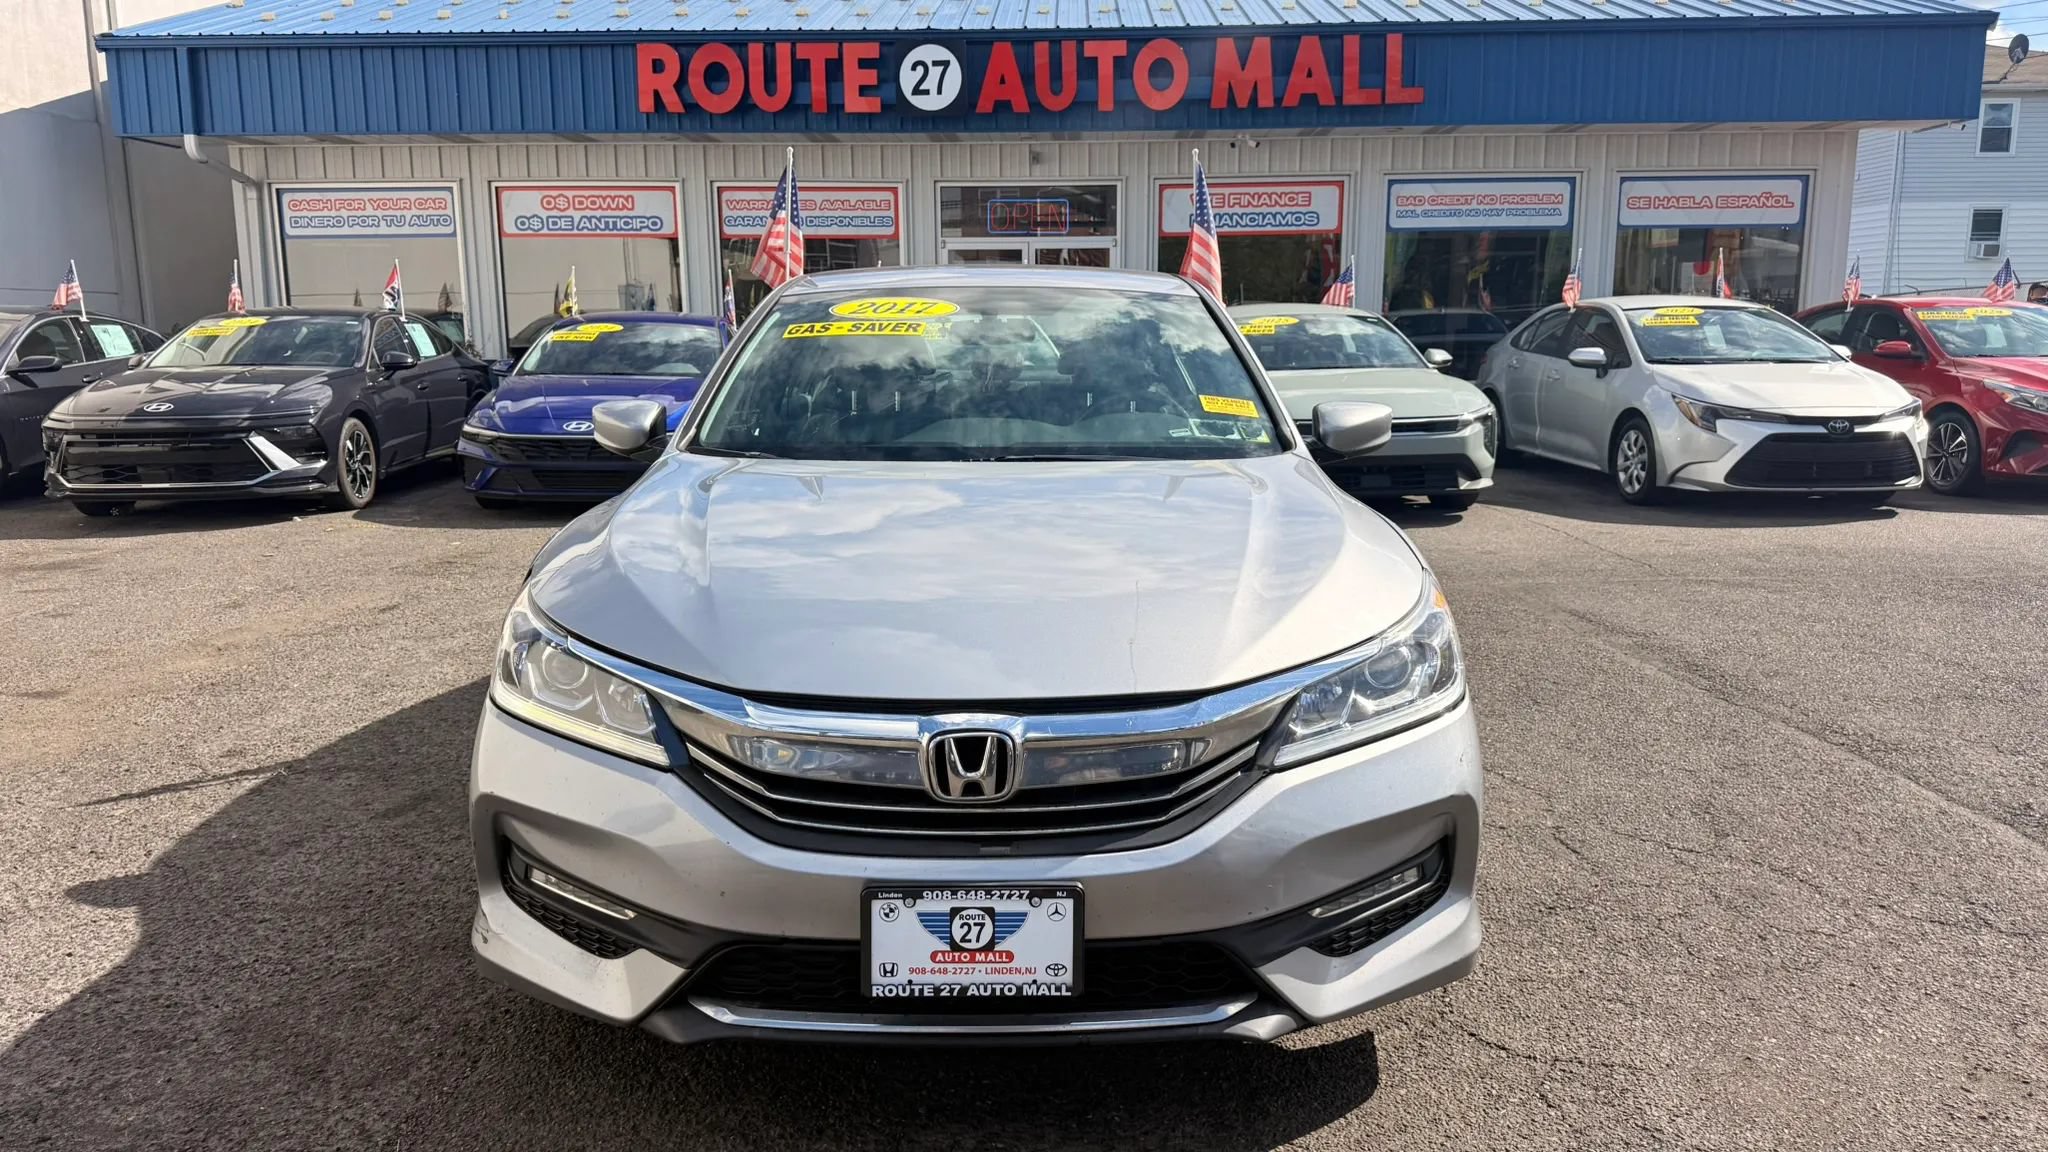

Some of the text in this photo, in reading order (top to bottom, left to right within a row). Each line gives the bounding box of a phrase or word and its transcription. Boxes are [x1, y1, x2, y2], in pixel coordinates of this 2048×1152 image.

[636, 34, 1425, 114] ROUTE 27 AUTO MALL
[288, 198, 448, 211] CASH FOR YOUR CAR
[572, 195, 634, 211] DOWN
[818, 200, 891, 210] AVAILABLE
[1190, 192, 1312, 208] E FINANCE
[1396, 193, 1563, 207] BAD CREDIT NO PROBLEM
[1627, 192, 1795, 209] SE HABLA ESPAÑOL
[991, 203, 1067, 231] OPEN
[1396, 207, 1562, 218] MAL CREDITO NO HAY PROBLEMA
[290, 215, 452, 228] DINERO POR TU AUTO
[546, 216, 574, 231] DE
[576, 216, 663, 232] ANTICIPO
[806, 216, 893, 227] DISPONIBLES
[847, 302, 941, 316] 2017
[787, 322, 834, 336] GAS
[847, 321, 924, 333] SAVER
[922, 890, 1030, 901] 908-648-2727
[959, 922, 986, 944] 27
[935, 952, 1009, 962] AUTO MALL
[908, 967, 1037, 976] 908-648-2727 LINDEN,NJ
[871, 983, 1072, 997] ROUTE 27 AUTO MALL
